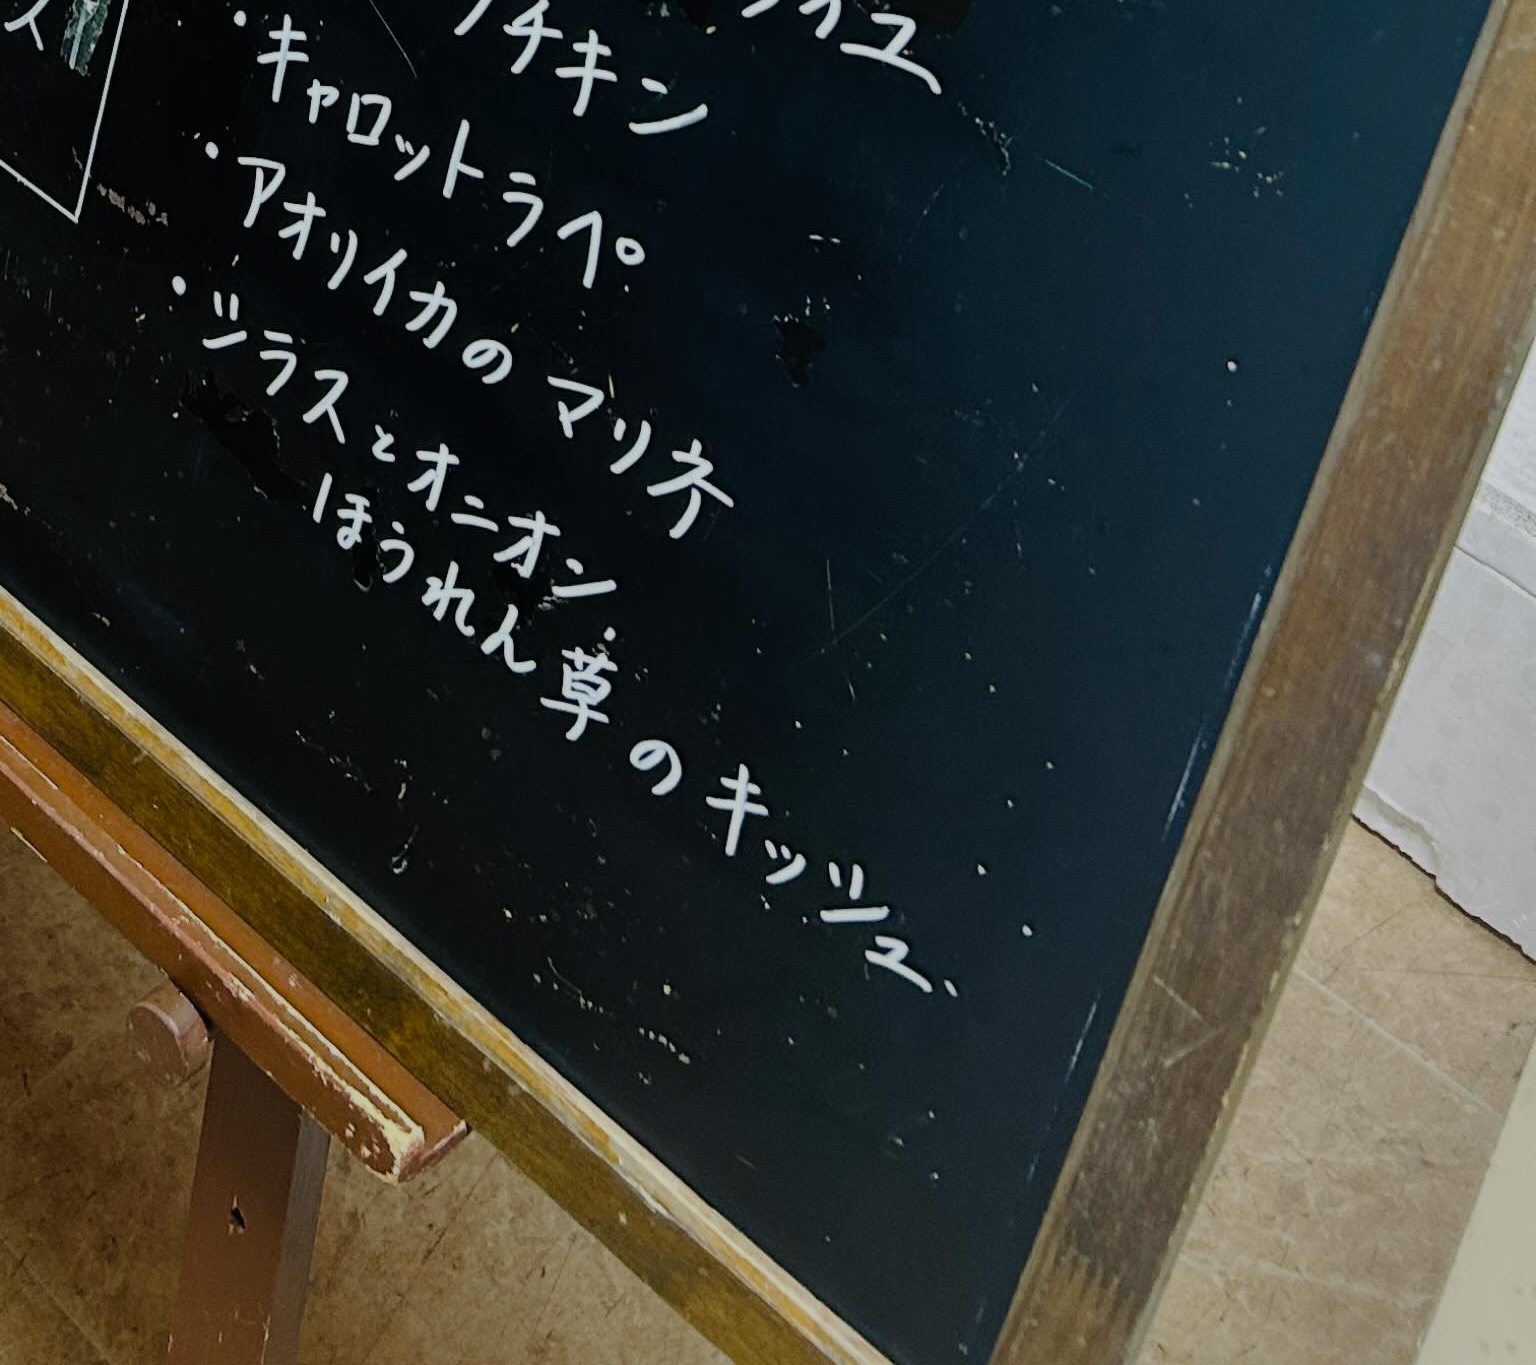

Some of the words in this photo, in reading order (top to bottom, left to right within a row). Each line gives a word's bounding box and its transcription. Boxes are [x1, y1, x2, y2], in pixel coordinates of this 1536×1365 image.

[312, 472, 934, 994] ほうれん草のキッシュ
